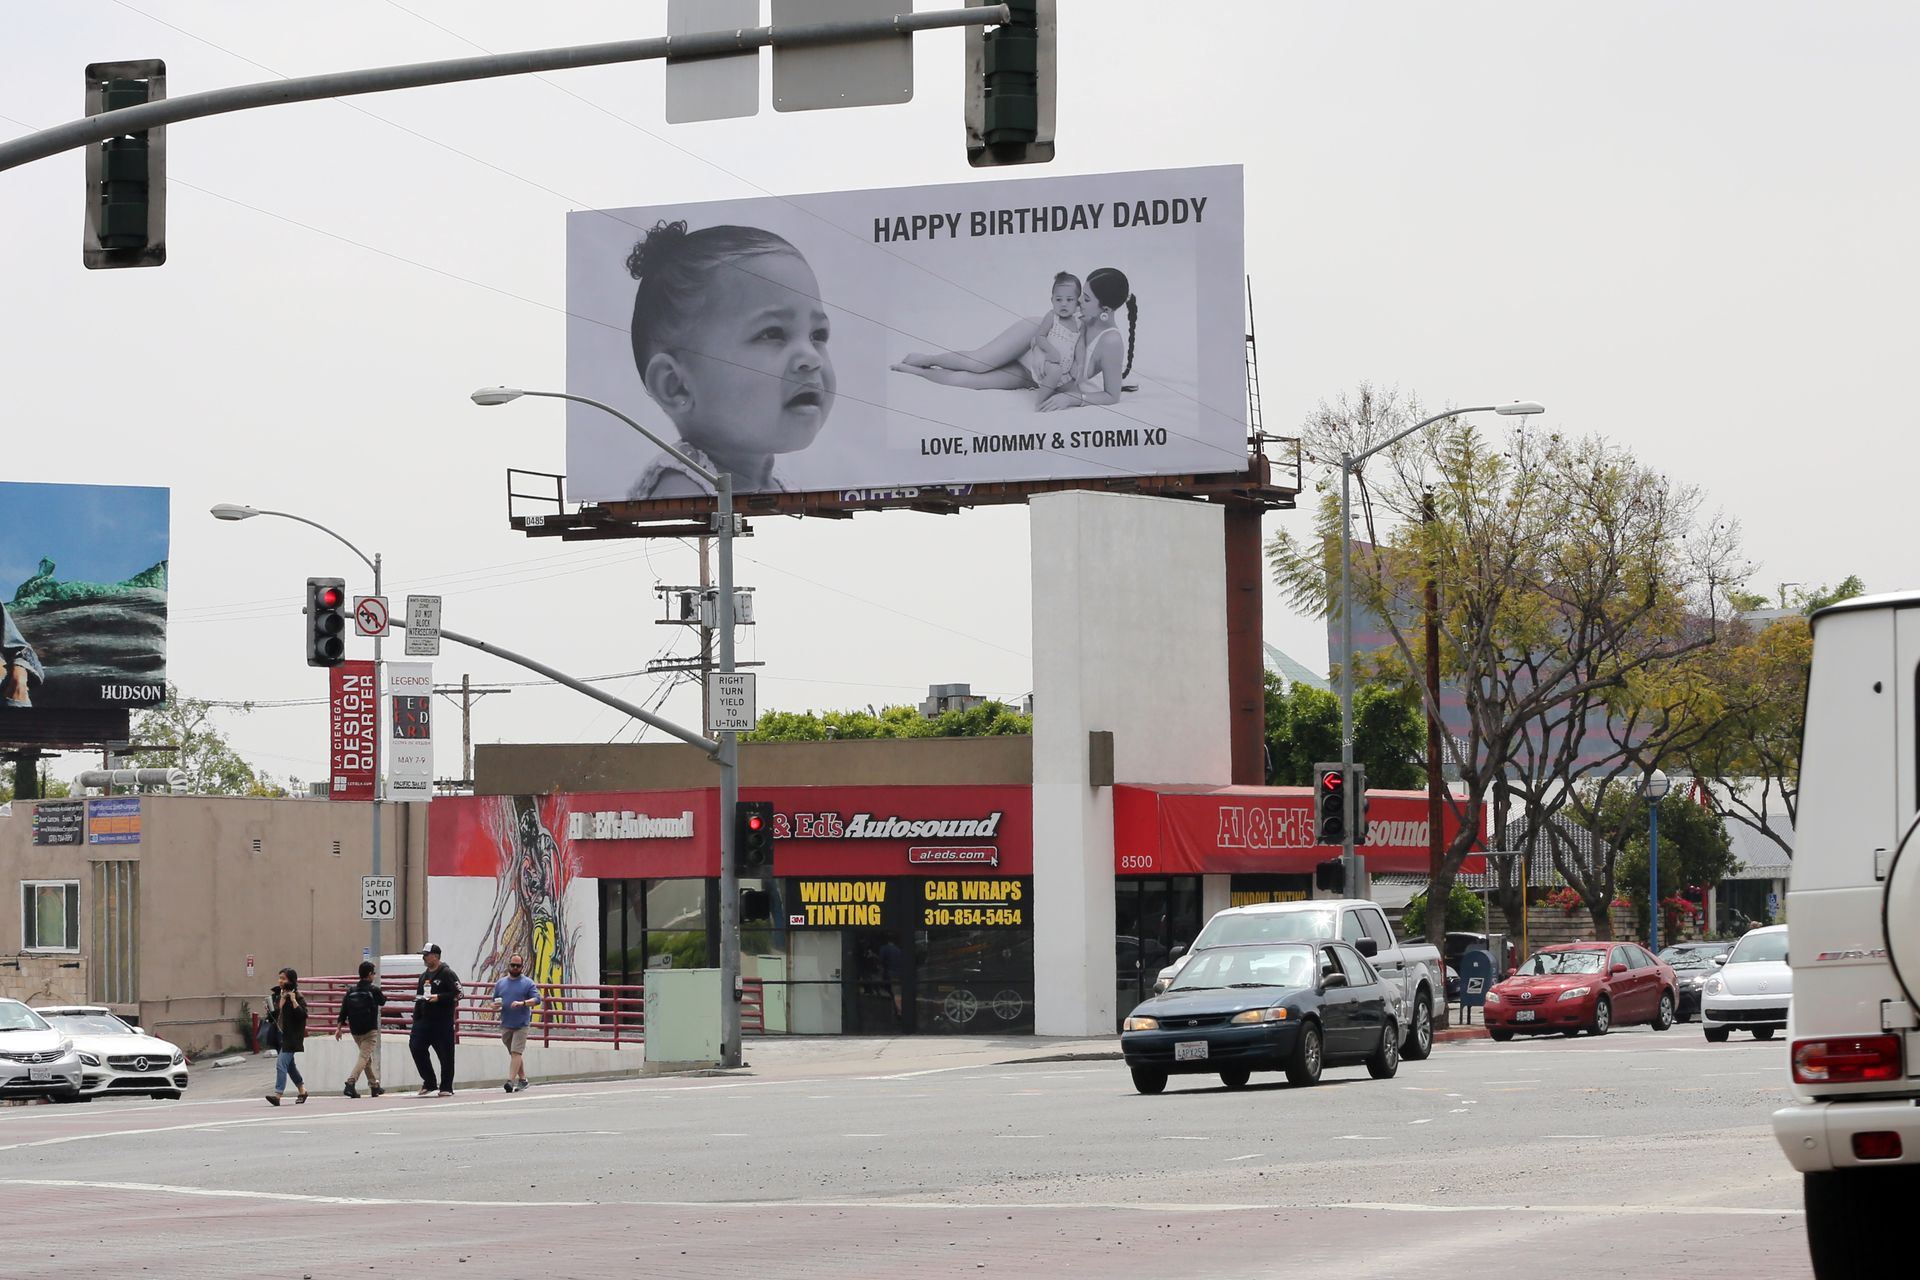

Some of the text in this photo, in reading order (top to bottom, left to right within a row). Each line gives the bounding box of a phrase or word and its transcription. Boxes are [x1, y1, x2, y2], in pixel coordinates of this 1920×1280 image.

[874, 197, 1207, 243] HAPPY BIRTHDAY DADDY
[921, 427, 1167, 456] LOVE, MOMMY & STORMI XO
[526, 516, 543, 525] 0485
[391, 676, 430, 686] LEGENDS
[719, 676, 744, 684] RIGHT
[101, 684, 161, 700] HUDSON
[721, 687, 743, 695] TURN
[720, 698, 744, 706] YIELD
[727, 708, 737, 717] TO
[343, 675, 360, 770] DESIGN
[361, 675, 374, 770] QUARTER
[716, 719, 748, 727] U-TURN
[333, 698, 342, 769] LA CIENEGA
[398, 756, 414, 764] MAY
[773, 812, 1002, 839] & Ed's Autosound
[1217, 807, 1244, 848] Al
[1248, 807, 1267, 848] &
[1268, 807, 1316, 849] Ed's
[919, 850, 985, 860] al-eds.com
[1121, 856, 1153, 868] 8500
[800, 881, 887, 903] WINDOW
[924, 881, 1022, 900] CAR WRAPS
[366, 899, 391, 914] 30
[790, 916, 804, 925] 3M
[806, 904, 881, 926] TINTING
[924, 908, 1022, 925] 310-854-5454
